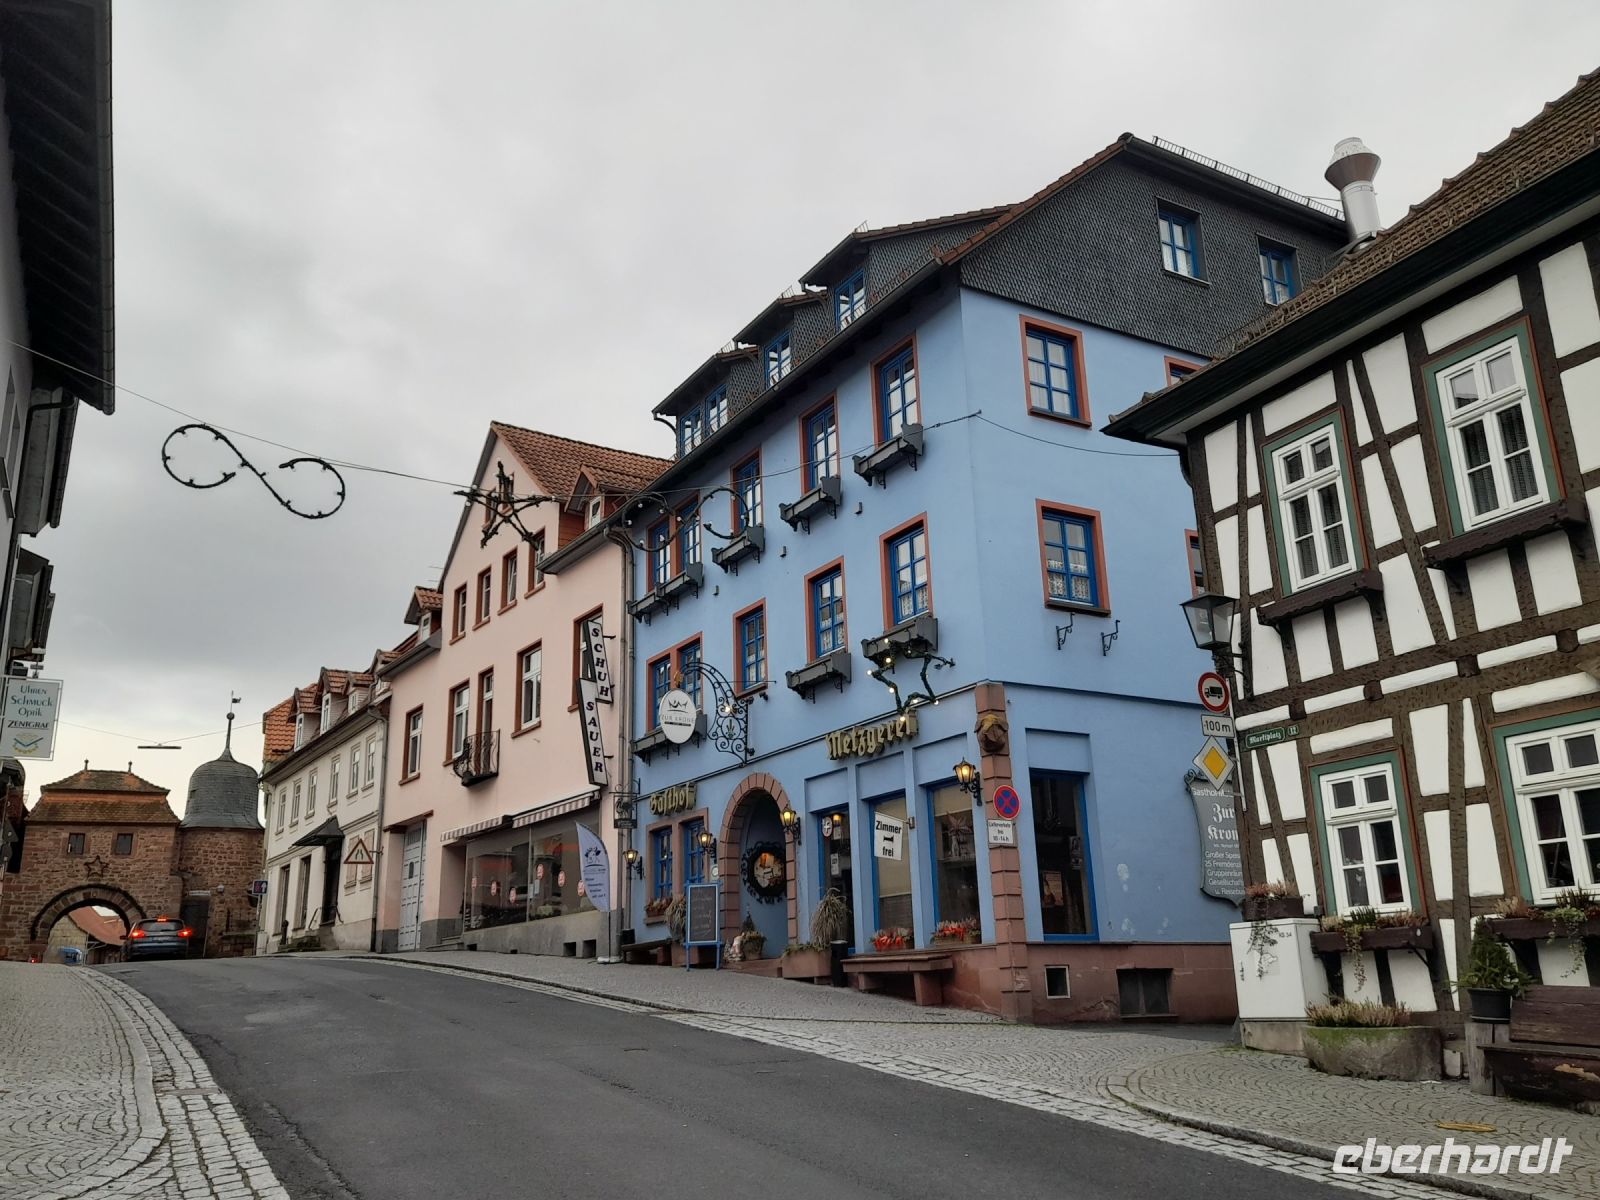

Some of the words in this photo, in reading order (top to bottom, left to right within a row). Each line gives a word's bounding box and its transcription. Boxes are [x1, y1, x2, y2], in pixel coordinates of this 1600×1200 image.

[591, 627, 609, 697] SCHUH
[11, 695, 52, 707] Schmuck
[19, 707, 42, 717] Optik
[8, 720, 49, 729] ZENTGRAF
[585, 701, 604, 773] SAUER
[825, 708, 913, 758] Metzgerei
[1212, 803, 1235, 823] Zur
[875, 820, 902, 834] Zimmer
[1207, 825, 1239, 841] Kron
[882, 846, 894, 857] frei
